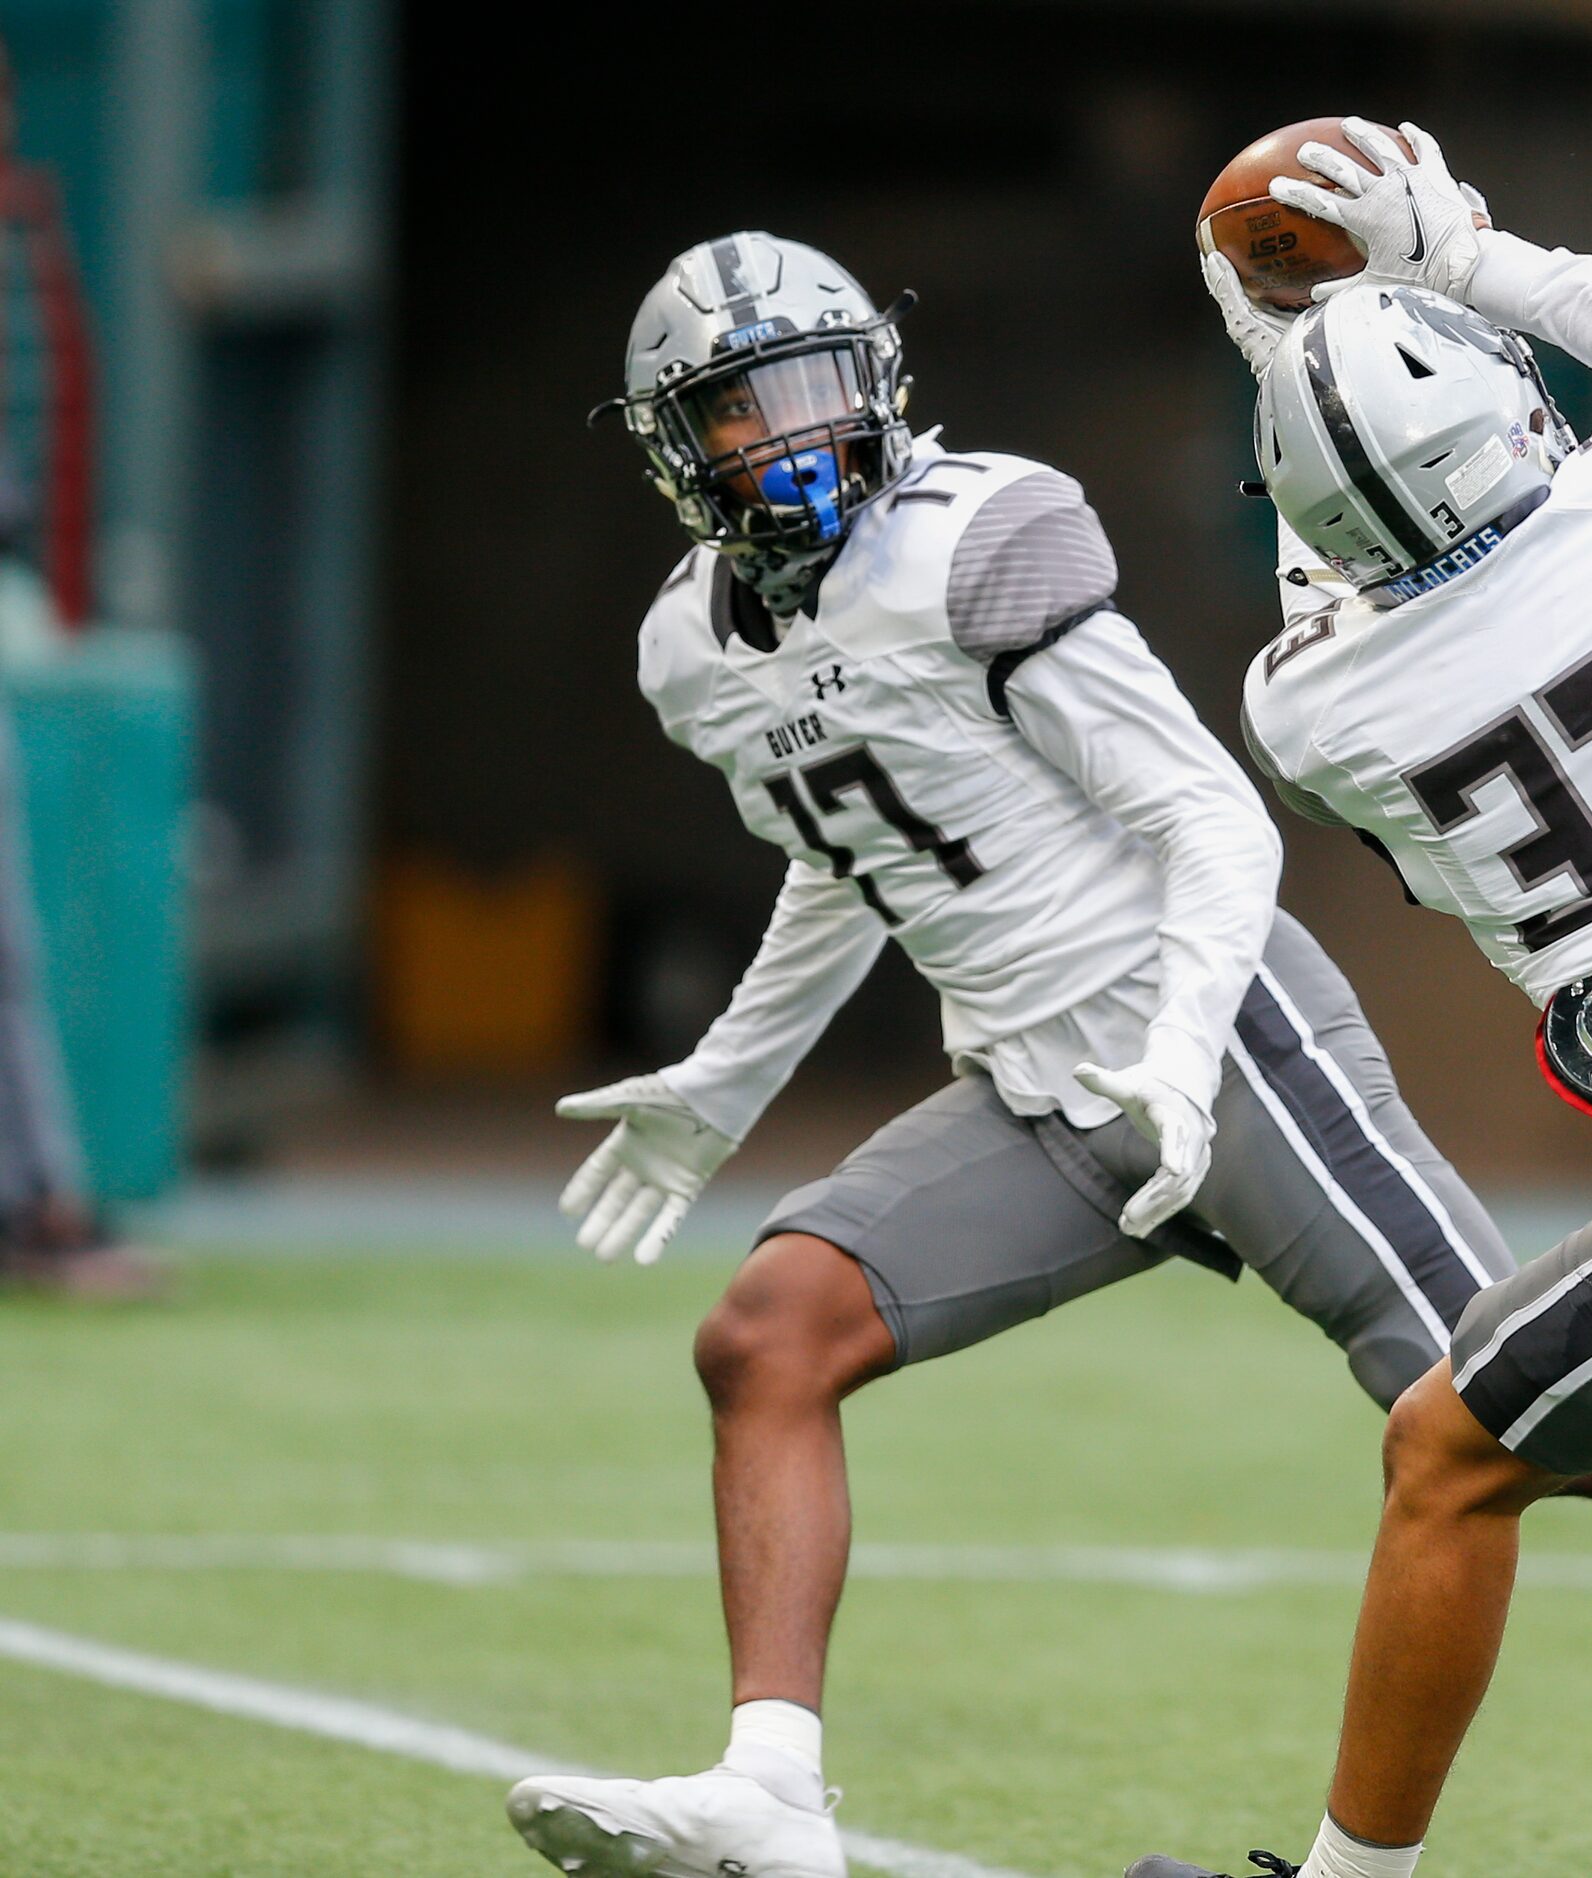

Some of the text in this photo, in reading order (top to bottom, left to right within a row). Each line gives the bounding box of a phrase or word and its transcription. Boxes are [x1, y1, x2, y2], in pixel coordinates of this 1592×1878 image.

[1248, 231, 1298, 259] GST
[1429, 500, 1467, 541] 3
[1384, 527, 1501, 603] WILDCATS
[765, 712, 828, 759] GUYER
[761, 740, 987, 927] 17
